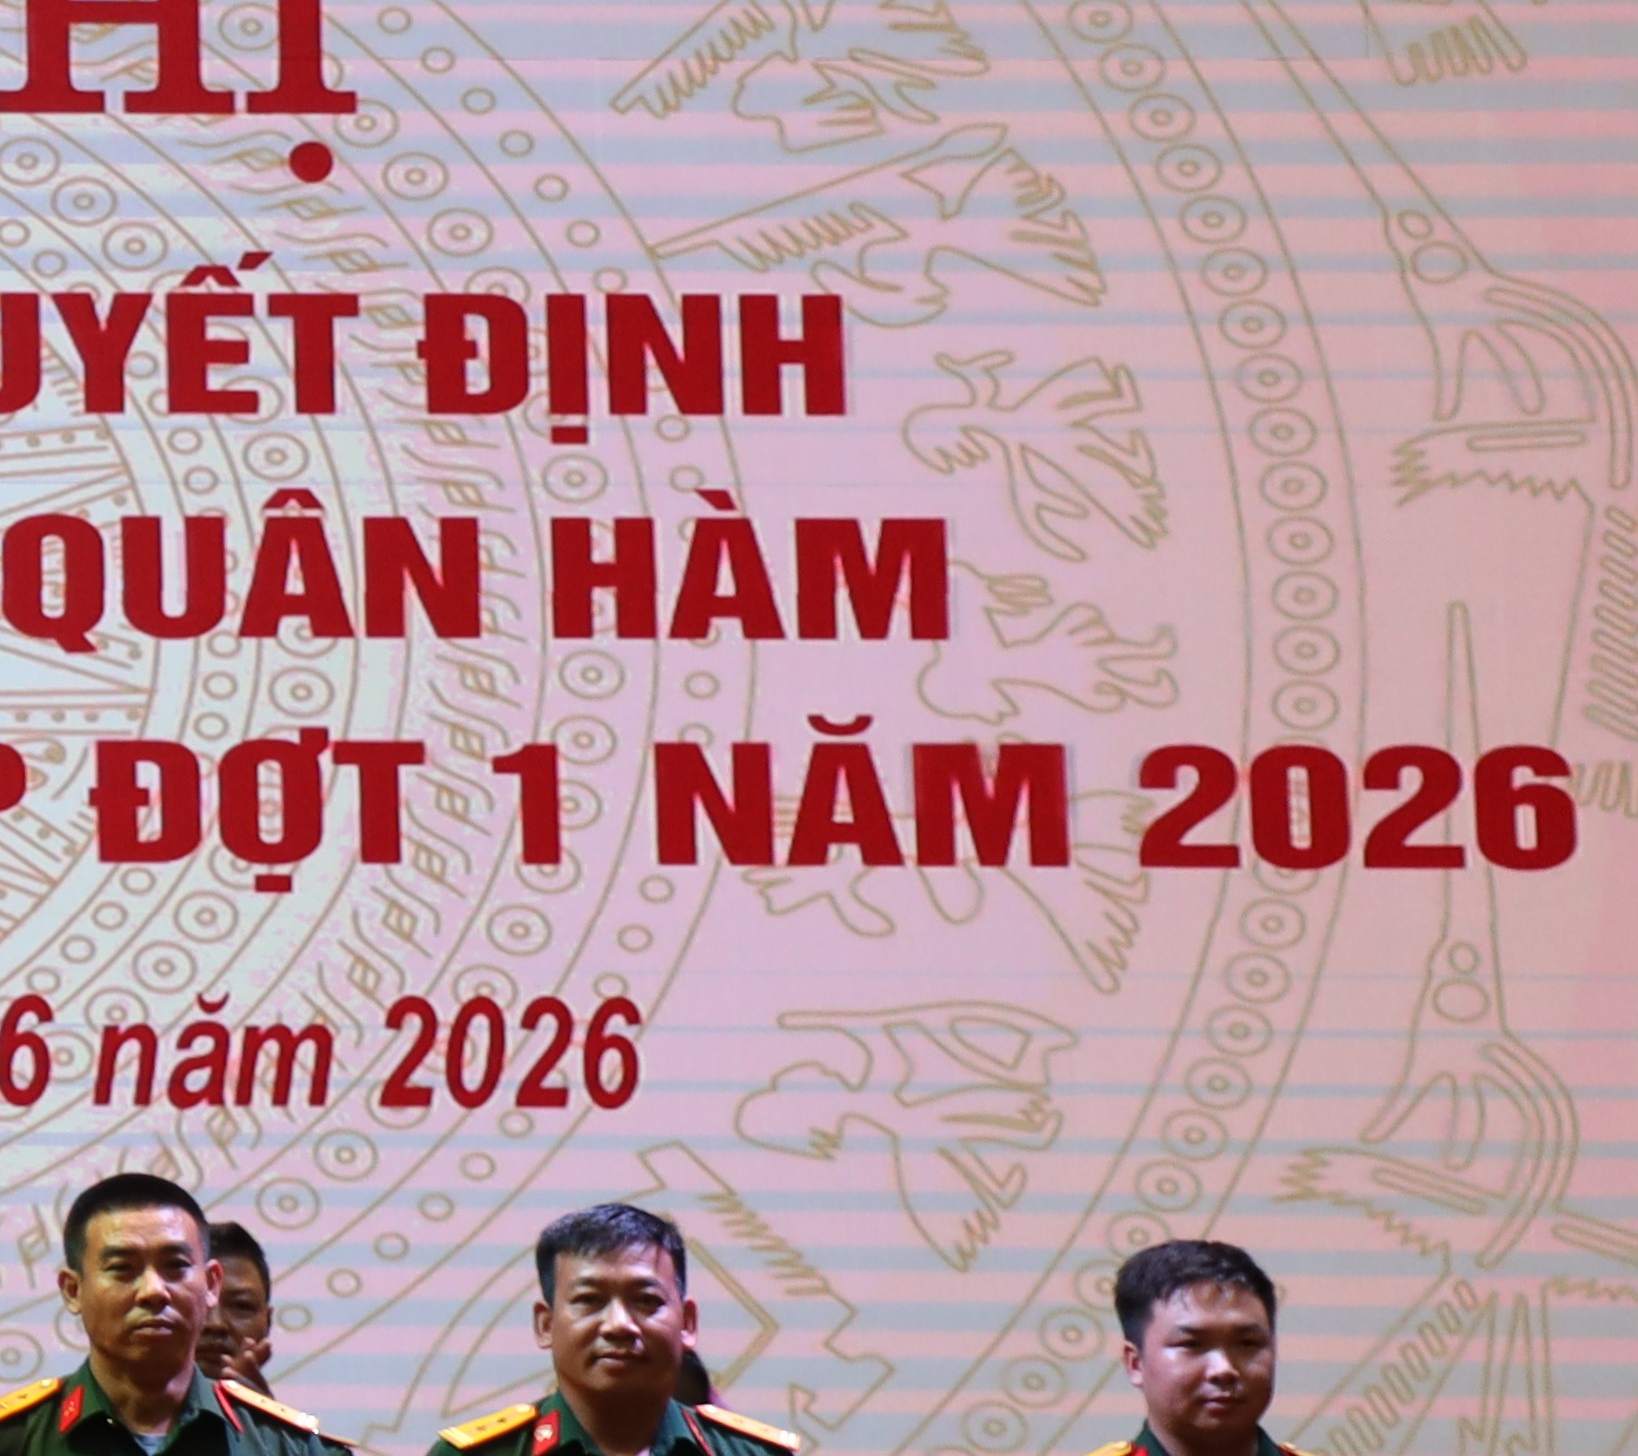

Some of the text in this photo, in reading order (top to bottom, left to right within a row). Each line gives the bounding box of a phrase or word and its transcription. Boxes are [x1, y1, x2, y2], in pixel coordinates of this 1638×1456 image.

[418, 293, 845, 444] ĐỊNH
[2, 489, 481, 653] QUÂN
[552, 490, 949, 640] HÀM
[91, 728, 425, 893] ĐỢT
[492, 744, 561, 865] 1
[655, 716, 1069, 867] NĂM
[1139, 745, 1577, 871] 2026
[95, 999, 333, 1109] năm
[381, 997, 641, 1109] 2026
